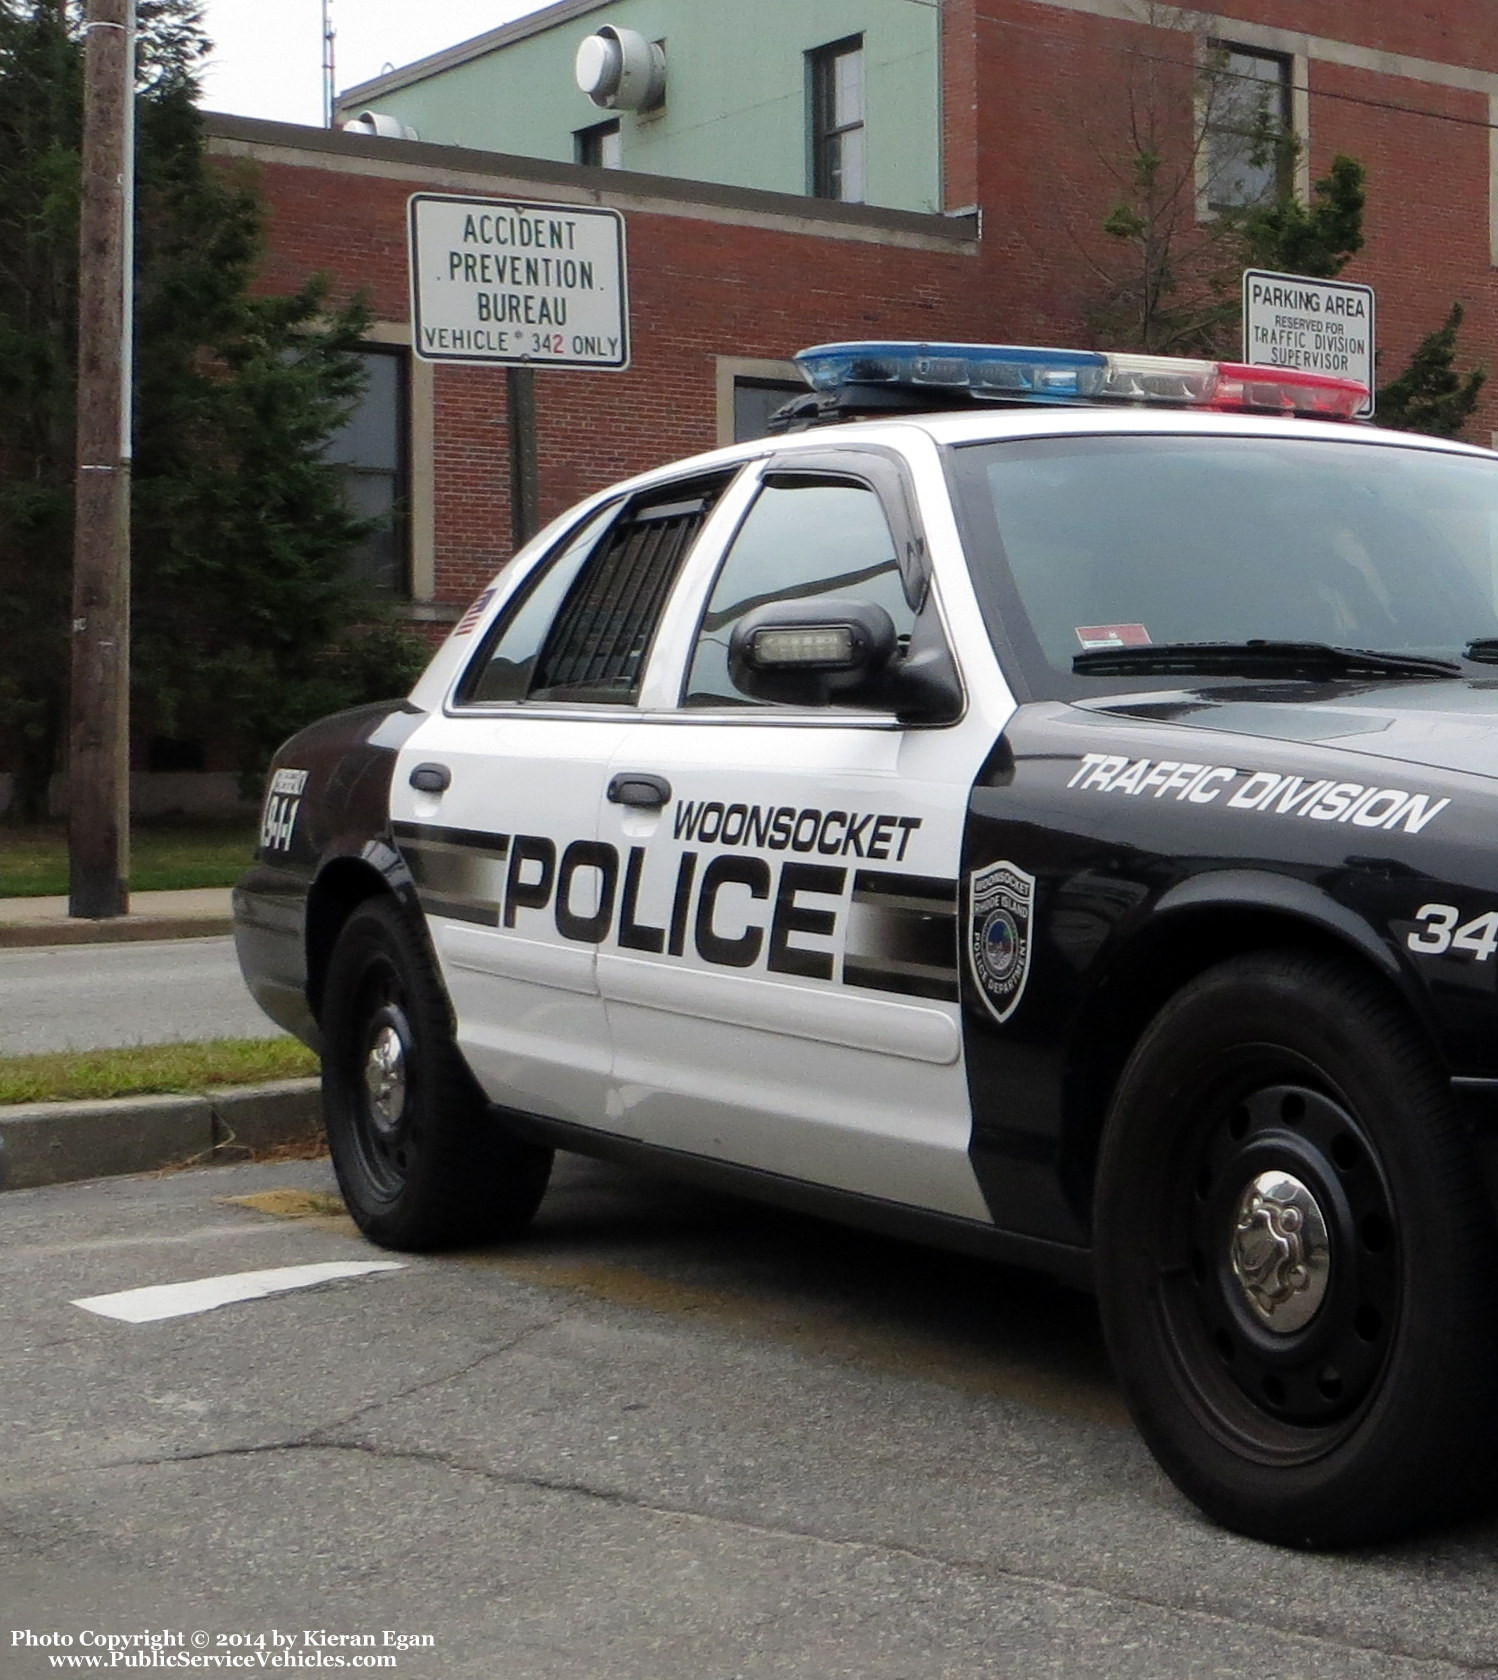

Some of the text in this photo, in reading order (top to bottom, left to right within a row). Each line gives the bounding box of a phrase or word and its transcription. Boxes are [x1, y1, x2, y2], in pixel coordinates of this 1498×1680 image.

[463, 214, 576, 250] ACCIDENT
[449, 251, 593, 289] PREVENTION
[477, 292, 567, 326] BUREAU
[1253, 284, 1365, 318] PARKING AREA
[424, 327, 509, 351] VEHICLE
[532, 332, 564, 353] 342
[572, 335, 618, 356] ONLY
[1254, 325, 1365, 355] TRAFFIC DIVISION
[1275, 315, 1344, 335] RESERVED FOR
[1271, 346, 1348, 371] SUPERVISOR
[1066, 753, 1452, 834] TRAFFIC DIVISION
[673, 800, 922, 862] WOONSOCKET
[974, 871, 1030, 896] WOONSOCKET
[503, 833, 848, 981] POLICE
[973, 932, 988, 982] POLICE
[987, 939, 1027, 995] DEPARTMENT
